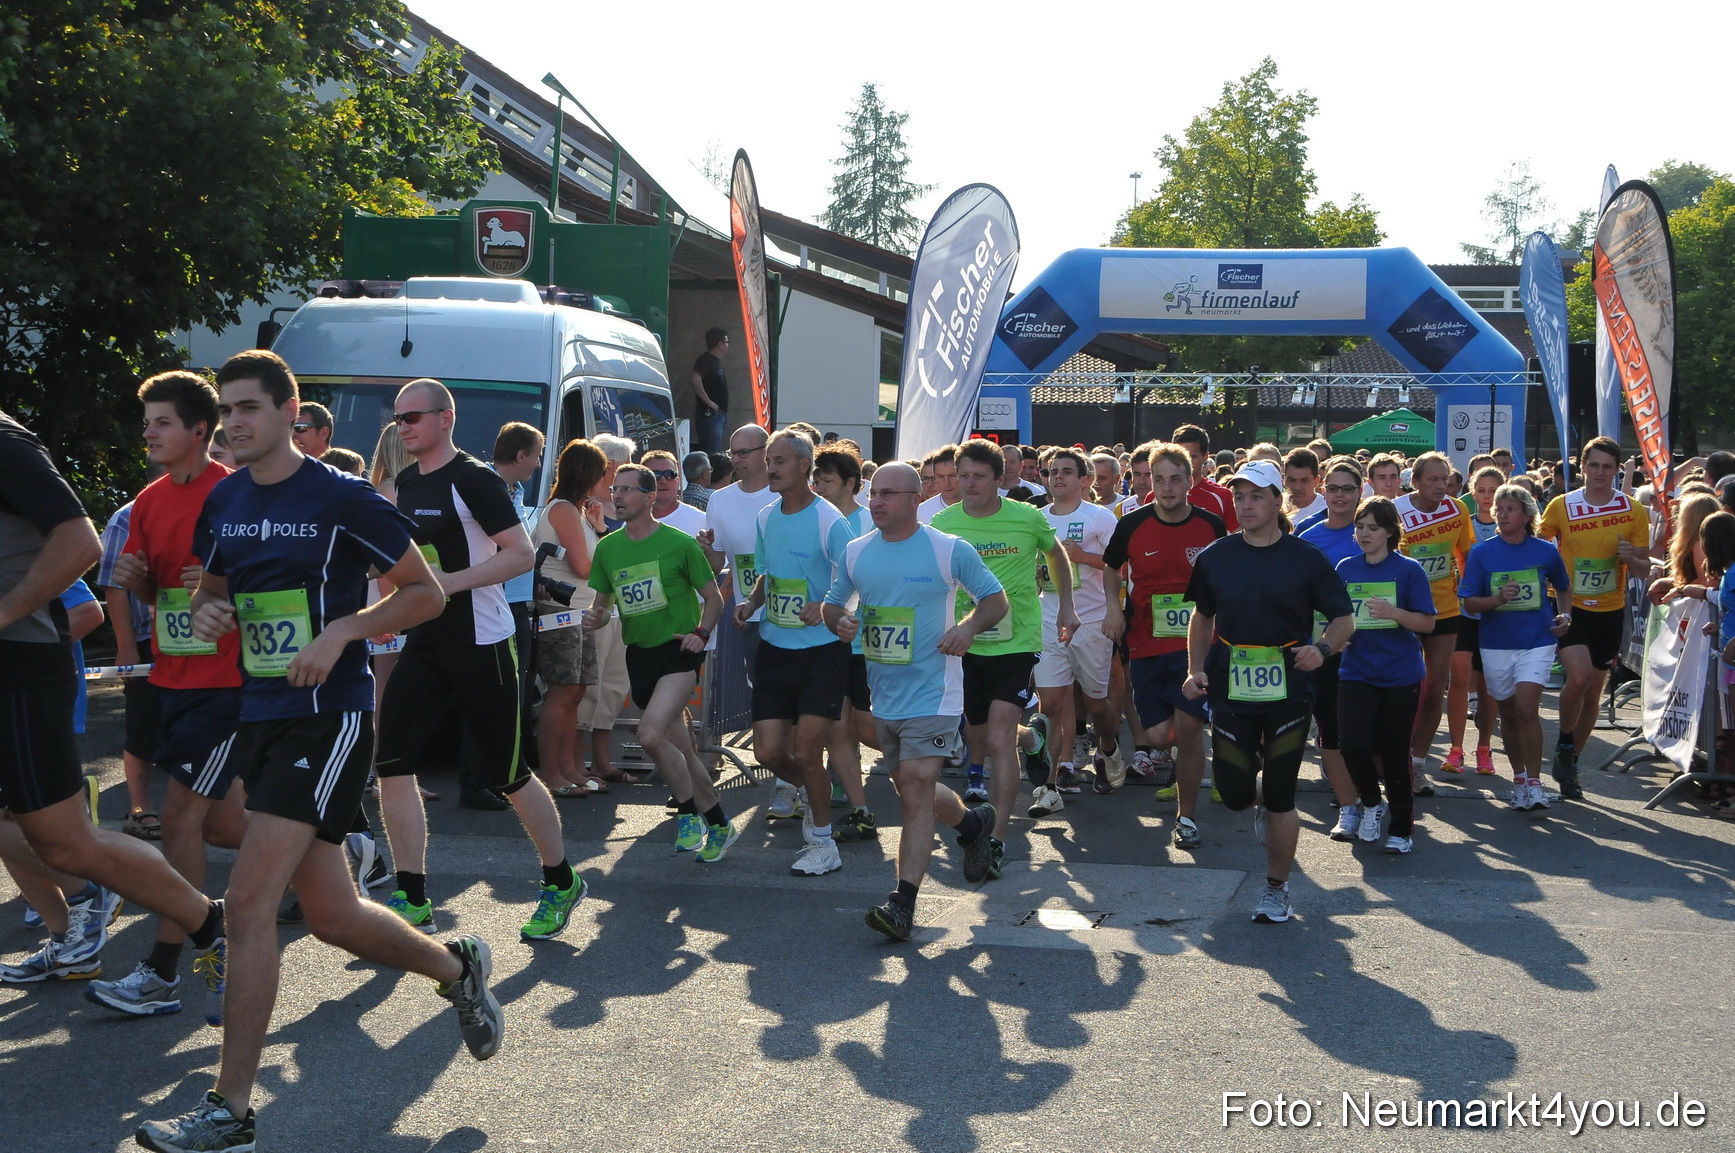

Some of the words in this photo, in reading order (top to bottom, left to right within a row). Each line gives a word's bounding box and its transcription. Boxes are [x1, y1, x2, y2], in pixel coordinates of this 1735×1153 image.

[491, 260, 516, 270] 1628
[936, 219, 995, 372] Fischer
[1201, 290, 1301, 308] firmenlauf
[961, 250, 1002, 371] AUTOMOBILE
[1014, 321, 1066, 333] Fischer
[1422, 322, 1437, 330] das
[221, 523, 259, 537] EURO
[272, 523, 318, 537] POLES
[1569, 521, 1598, 533] MAX
[1602, 515, 1633, 528] BÖGL
[1407, 530, 1435, 545] MAX
[1418, 556, 1446, 573] 772
[1579, 571, 1611, 587] 757
[621, 579, 653, 605] 567
[766, 591, 804, 616] 1373
[246, 620, 299, 656] 332
[862, 625, 910, 650] 1374
[1231, 666, 1283, 688] 1180
